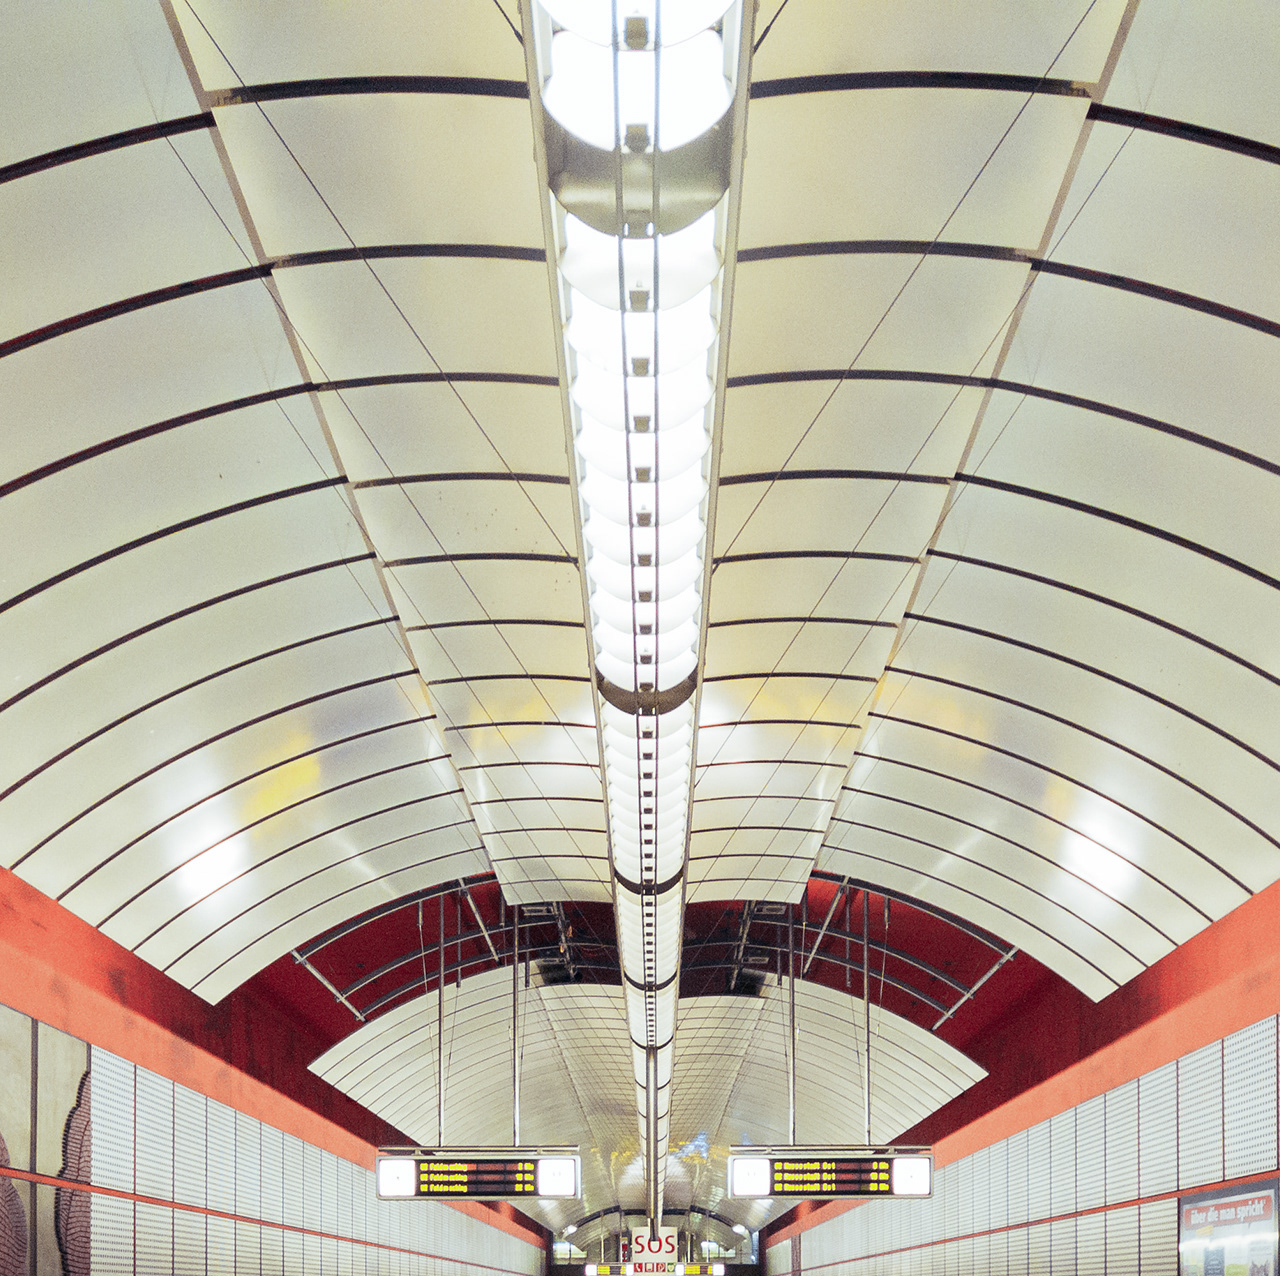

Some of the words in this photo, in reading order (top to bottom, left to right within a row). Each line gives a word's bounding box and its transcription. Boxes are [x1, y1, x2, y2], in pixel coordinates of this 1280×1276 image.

[1207, 1206, 1218, 1223] die
[1220, 1207, 1235, 1221] man
[634, 1235, 675, 1254] SOS
